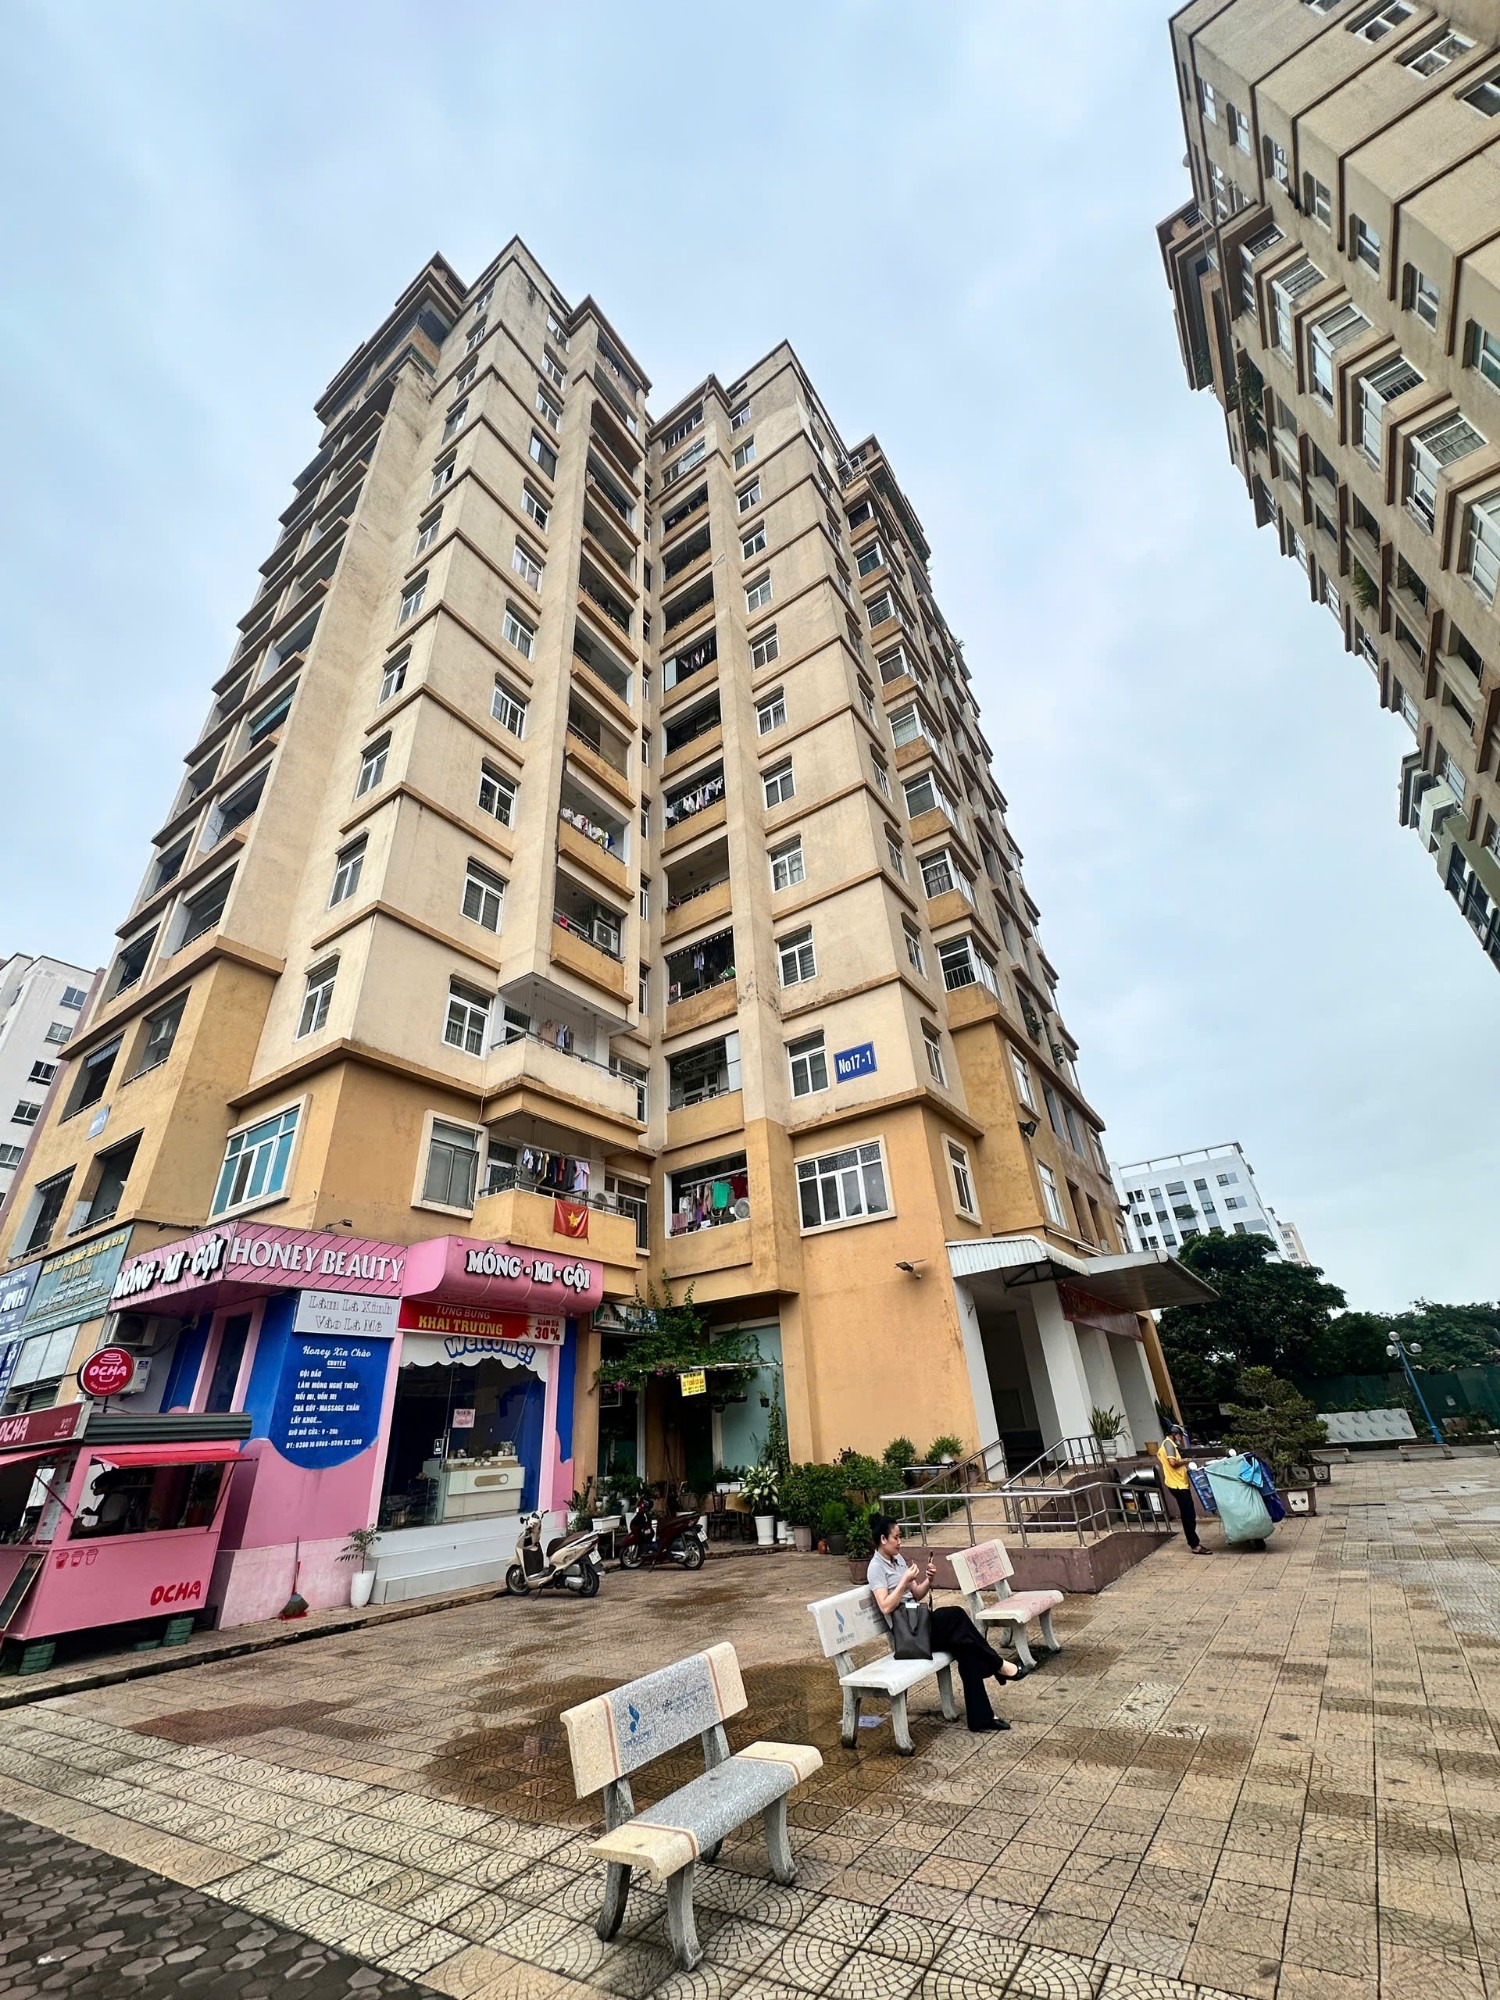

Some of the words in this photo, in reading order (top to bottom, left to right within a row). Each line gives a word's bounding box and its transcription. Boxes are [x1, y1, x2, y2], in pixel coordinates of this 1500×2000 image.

[111, 1261, 156, 1299] MÓNG
[161, 1252, 185, 1283] MI
[191, 1234, 225, 1279] GỘI
[229, 1238, 319, 1272] HONEY
[320, 1250, 404, 1282] BEAUTY
[466, 1247, 521, 1278] MÓNG
[534, 1261, 554, 1283] MI
[562, 1262, 591, 1293] GỘI
[308, 1296, 339, 1310] Làm
[361, 1301, 392, 1315] Xinh
[418, 1316, 450, 1331] KHAI
[535, 1327, 560, 1341] 30%
[445, 1336, 536, 1365] Welcome!
[89, 1365, 127, 1376] OCHA
[0, 1417, 30, 1442] OCHA
[150, 1580, 201, 1606] OCHA
